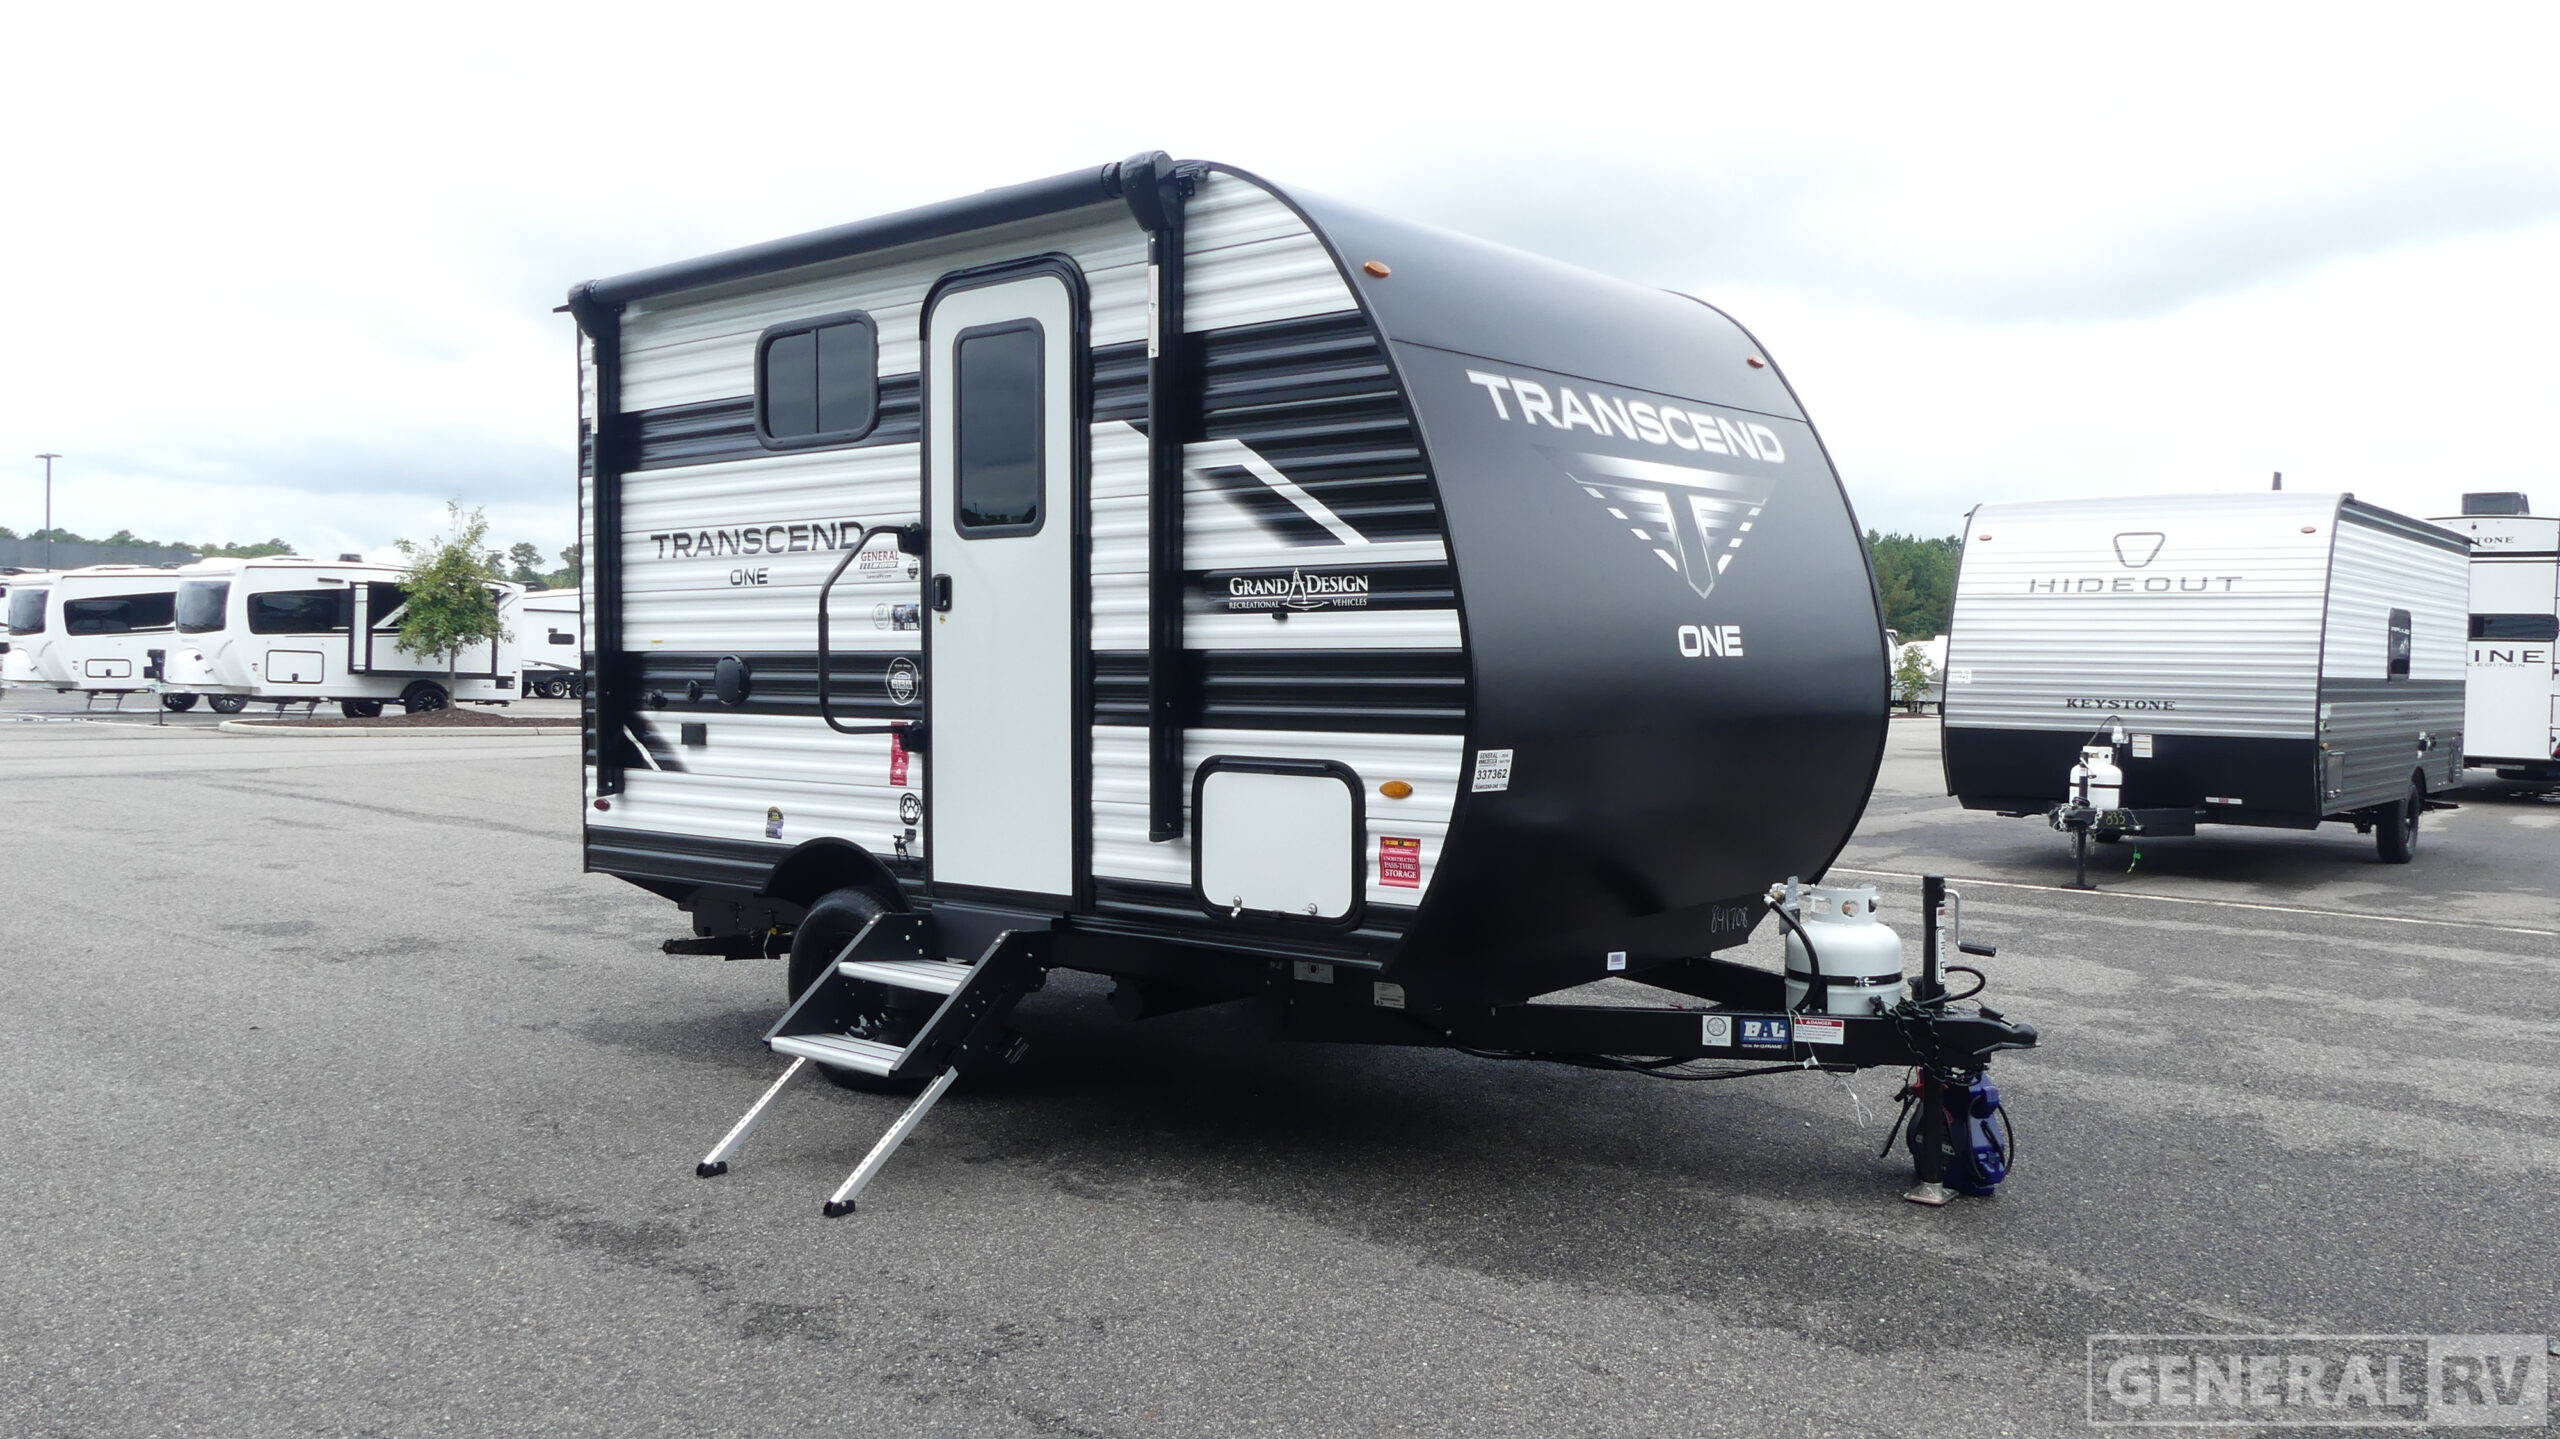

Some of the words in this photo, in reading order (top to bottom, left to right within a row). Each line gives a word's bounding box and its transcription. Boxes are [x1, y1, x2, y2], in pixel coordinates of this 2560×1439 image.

[1465, 369, 1786, 464] TRANSCEND
[650, 521, 864, 559] TRANSCEND
[2474, 536, 2514, 544] TONE
[861, 551, 899, 562] GENERAL
[730, 567, 768, 586] ONE
[1229, 578, 1289, 596] GRAND
[1306, 575, 1369, 594] DESIGN
[2029, 575, 2243, 594] HIDEOUT
[1229, 600, 1280, 610] RECREATIONAL
[1332, 598, 1368, 607] VEHICLES
[1678, 624, 1744, 658] ONE
[2474, 649, 2545, 663] INE
[2065, 697, 2176, 711] KEYSTONE
[1476, 768, 1508, 780] 337362
[2105, 811, 2126, 826] 833
[1384, 862, 1416, 870] PASS-THRU
[1384, 869, 1417, 878] STORAGE
[1710, 904, 1748, 933] 841708
